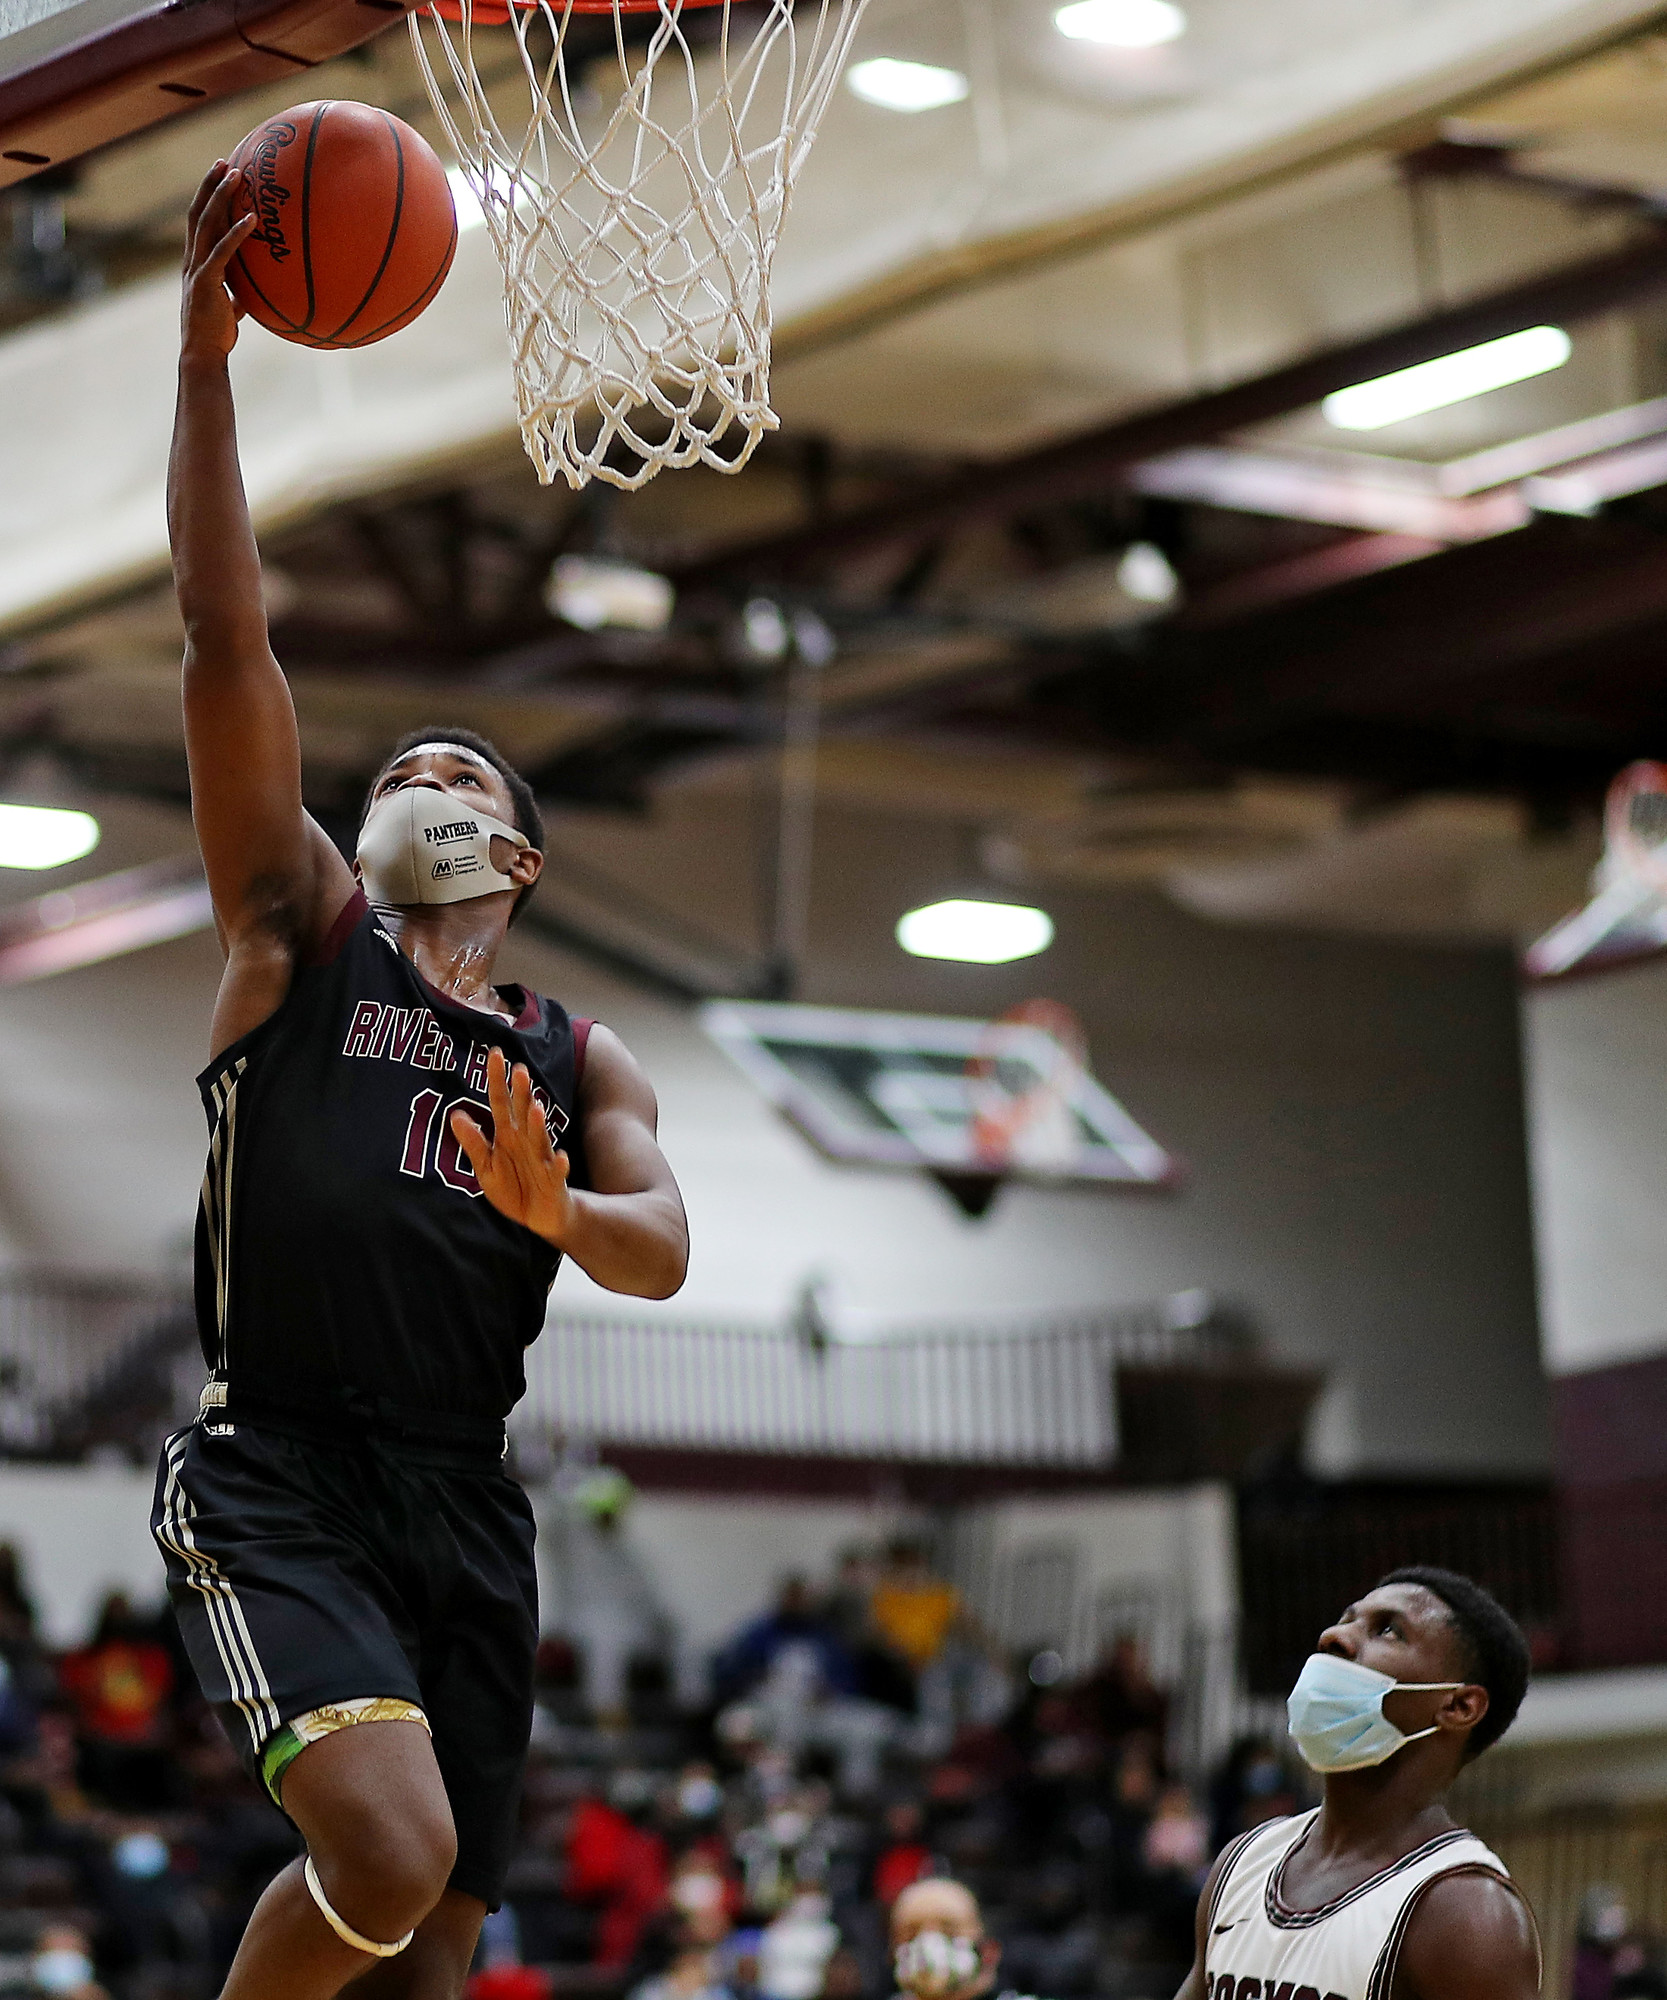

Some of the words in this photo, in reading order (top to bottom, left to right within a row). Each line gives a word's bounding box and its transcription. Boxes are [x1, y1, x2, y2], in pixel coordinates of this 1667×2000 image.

[250, 122, 296, 263] Rawlings
[424, 821, 479, 842] PANTHERS
[342, 1000, 457, 1071] RIVER
